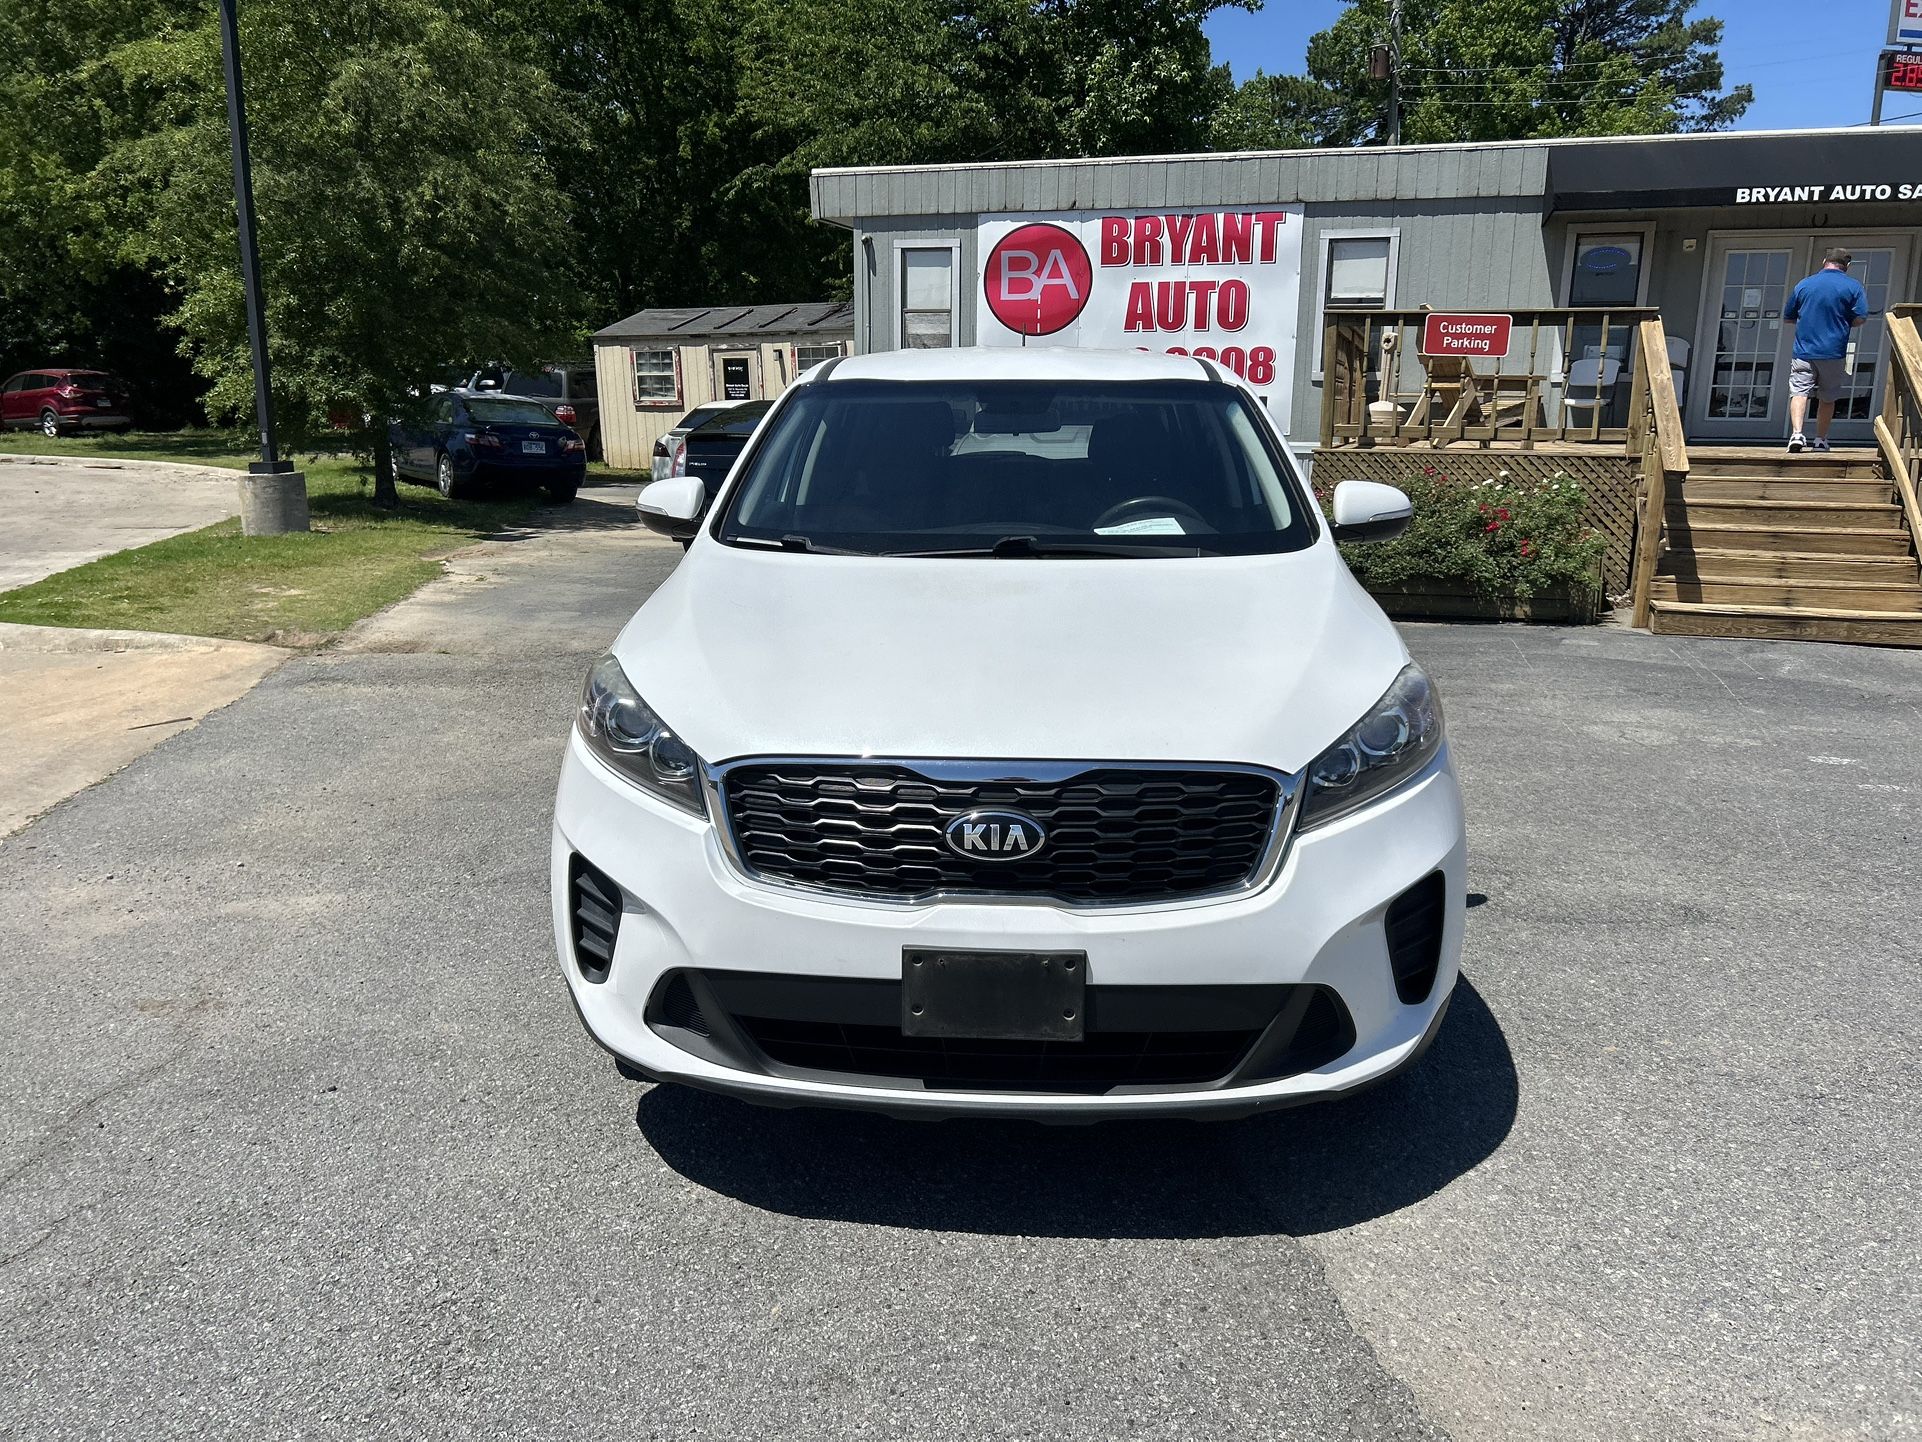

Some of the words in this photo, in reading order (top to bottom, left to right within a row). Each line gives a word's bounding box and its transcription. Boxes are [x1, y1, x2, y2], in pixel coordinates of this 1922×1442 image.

[1905, 0, 1922, 18] E
[1736, 185, 1824, 203] BRYANT
[1829, 184, 1892, 200] AUTO
[1897, 184, 1922, 200] SA
[1101, 211, 1287, 267] BRYANT
[1000, 249, 1080, 301] BA
[1123, 279, 1250, 333] AUTO
[1439, 321, 1498, 335] Customer
[1442, 336, 1490, 352] Parking
[962, 823, 1029, 851] KIA
